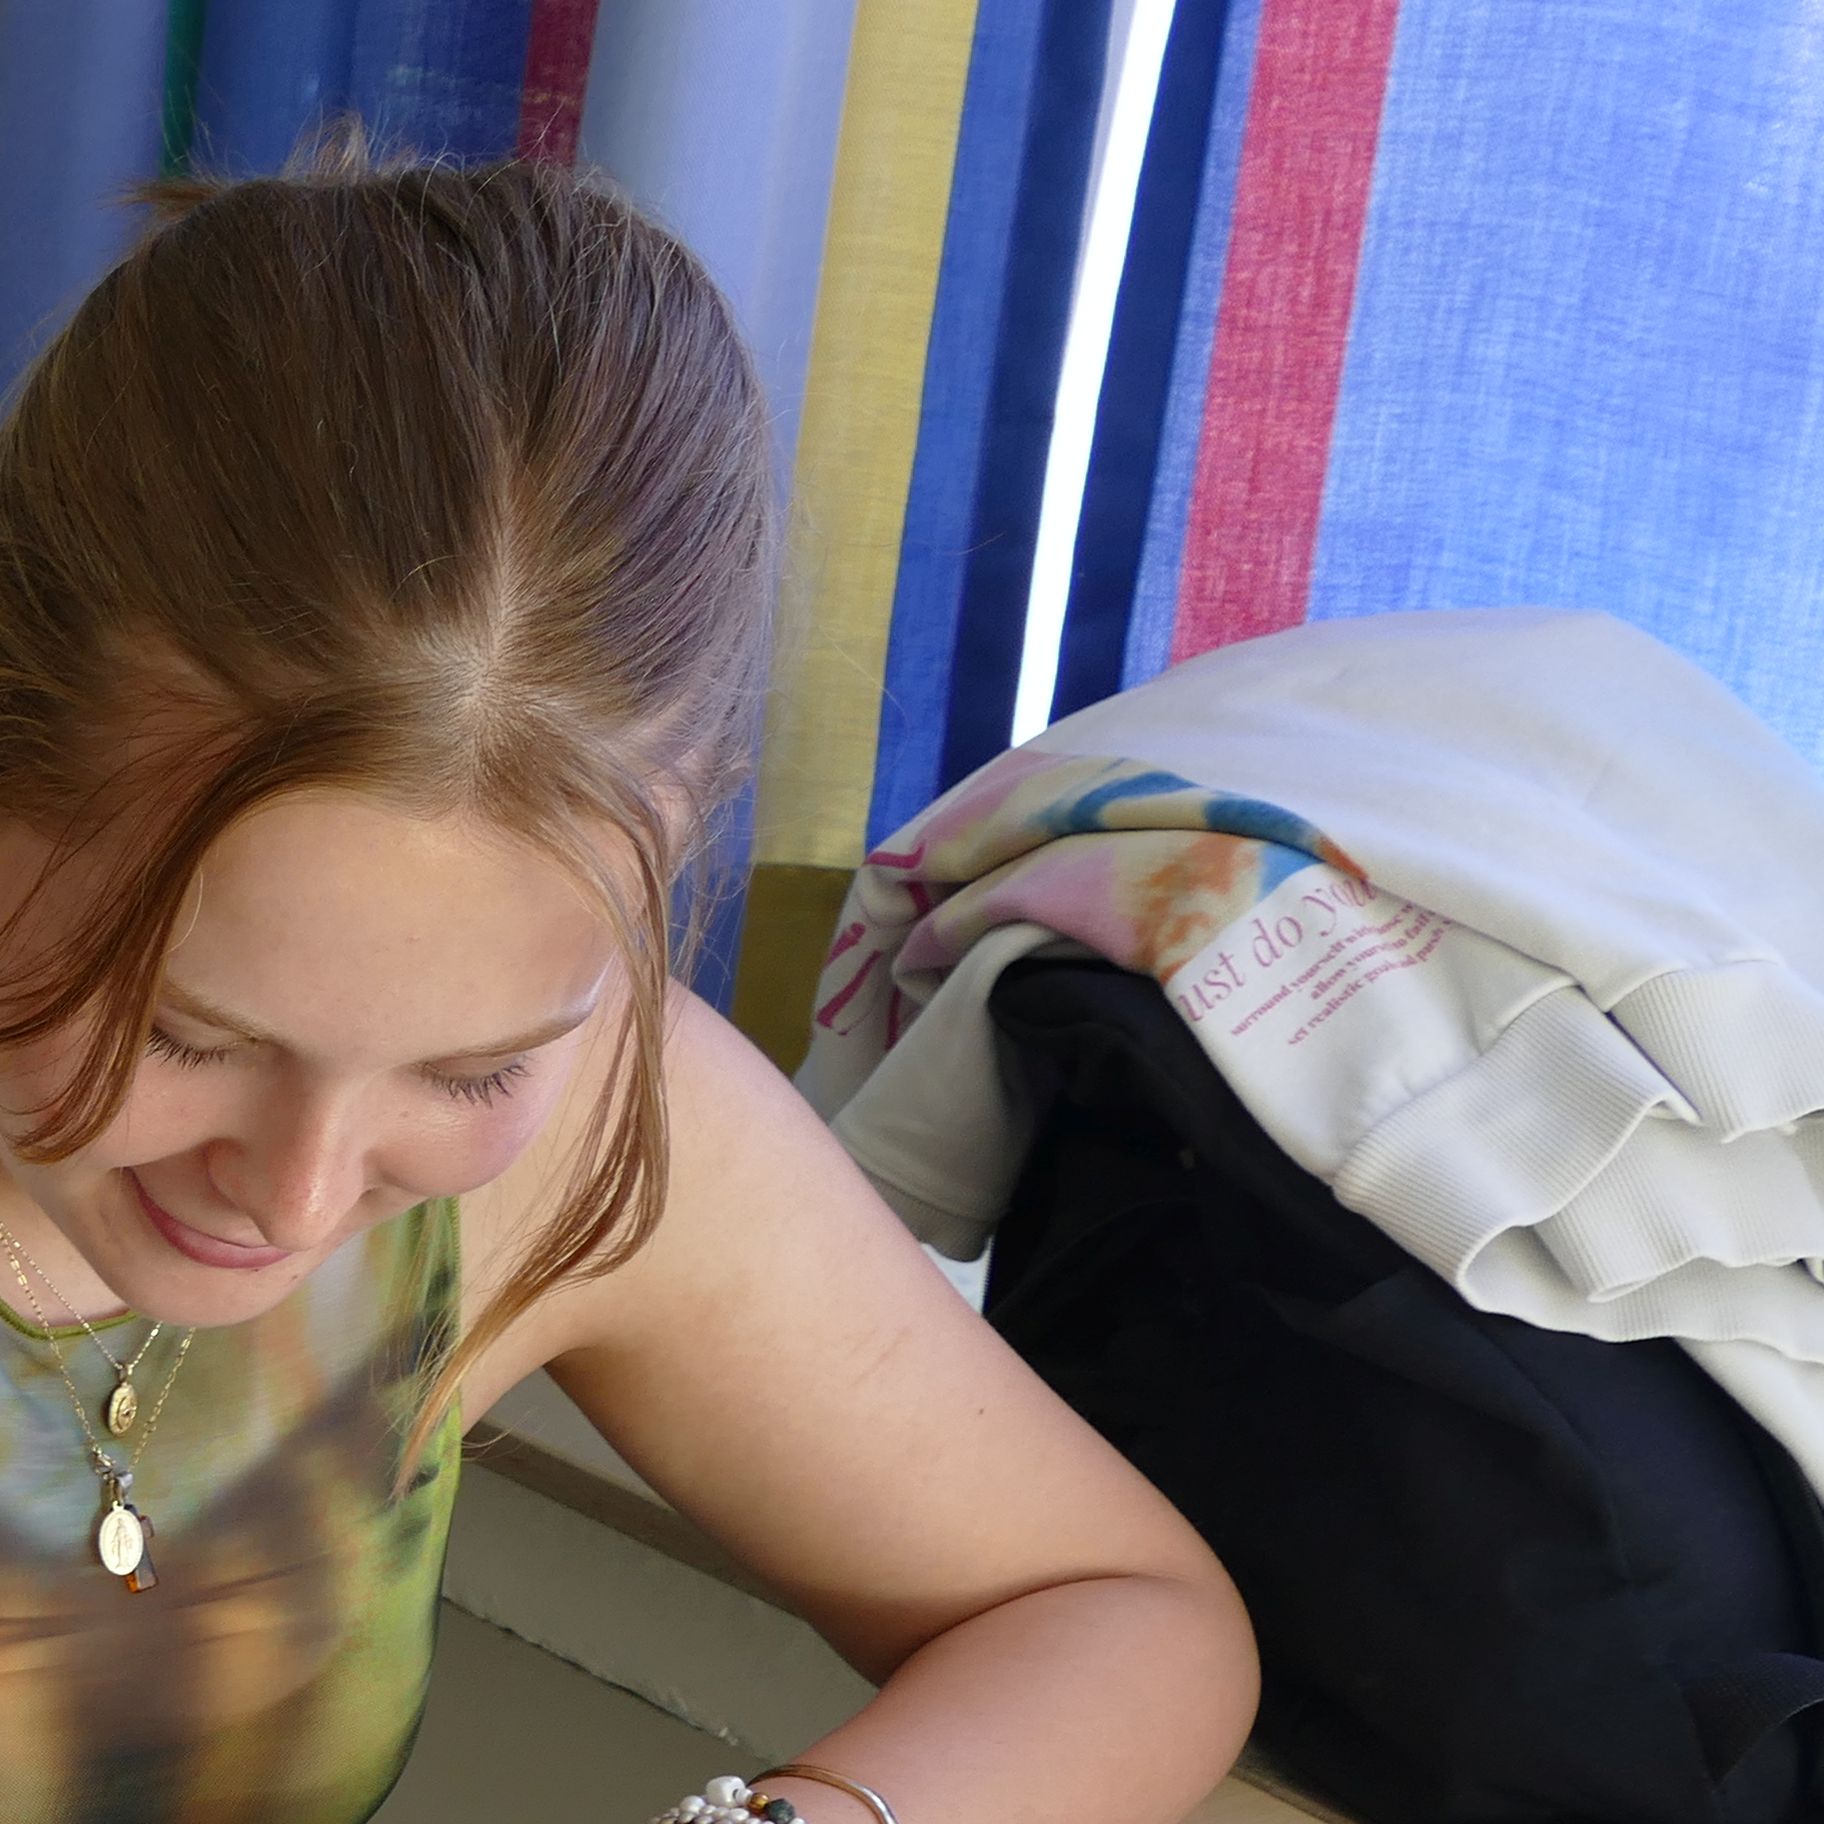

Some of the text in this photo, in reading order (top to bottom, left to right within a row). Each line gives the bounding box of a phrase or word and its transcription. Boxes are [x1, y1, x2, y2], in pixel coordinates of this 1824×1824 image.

[1253, 917, 1302, 967] do
[1232, 941, 1345, 1035] surround yourself
